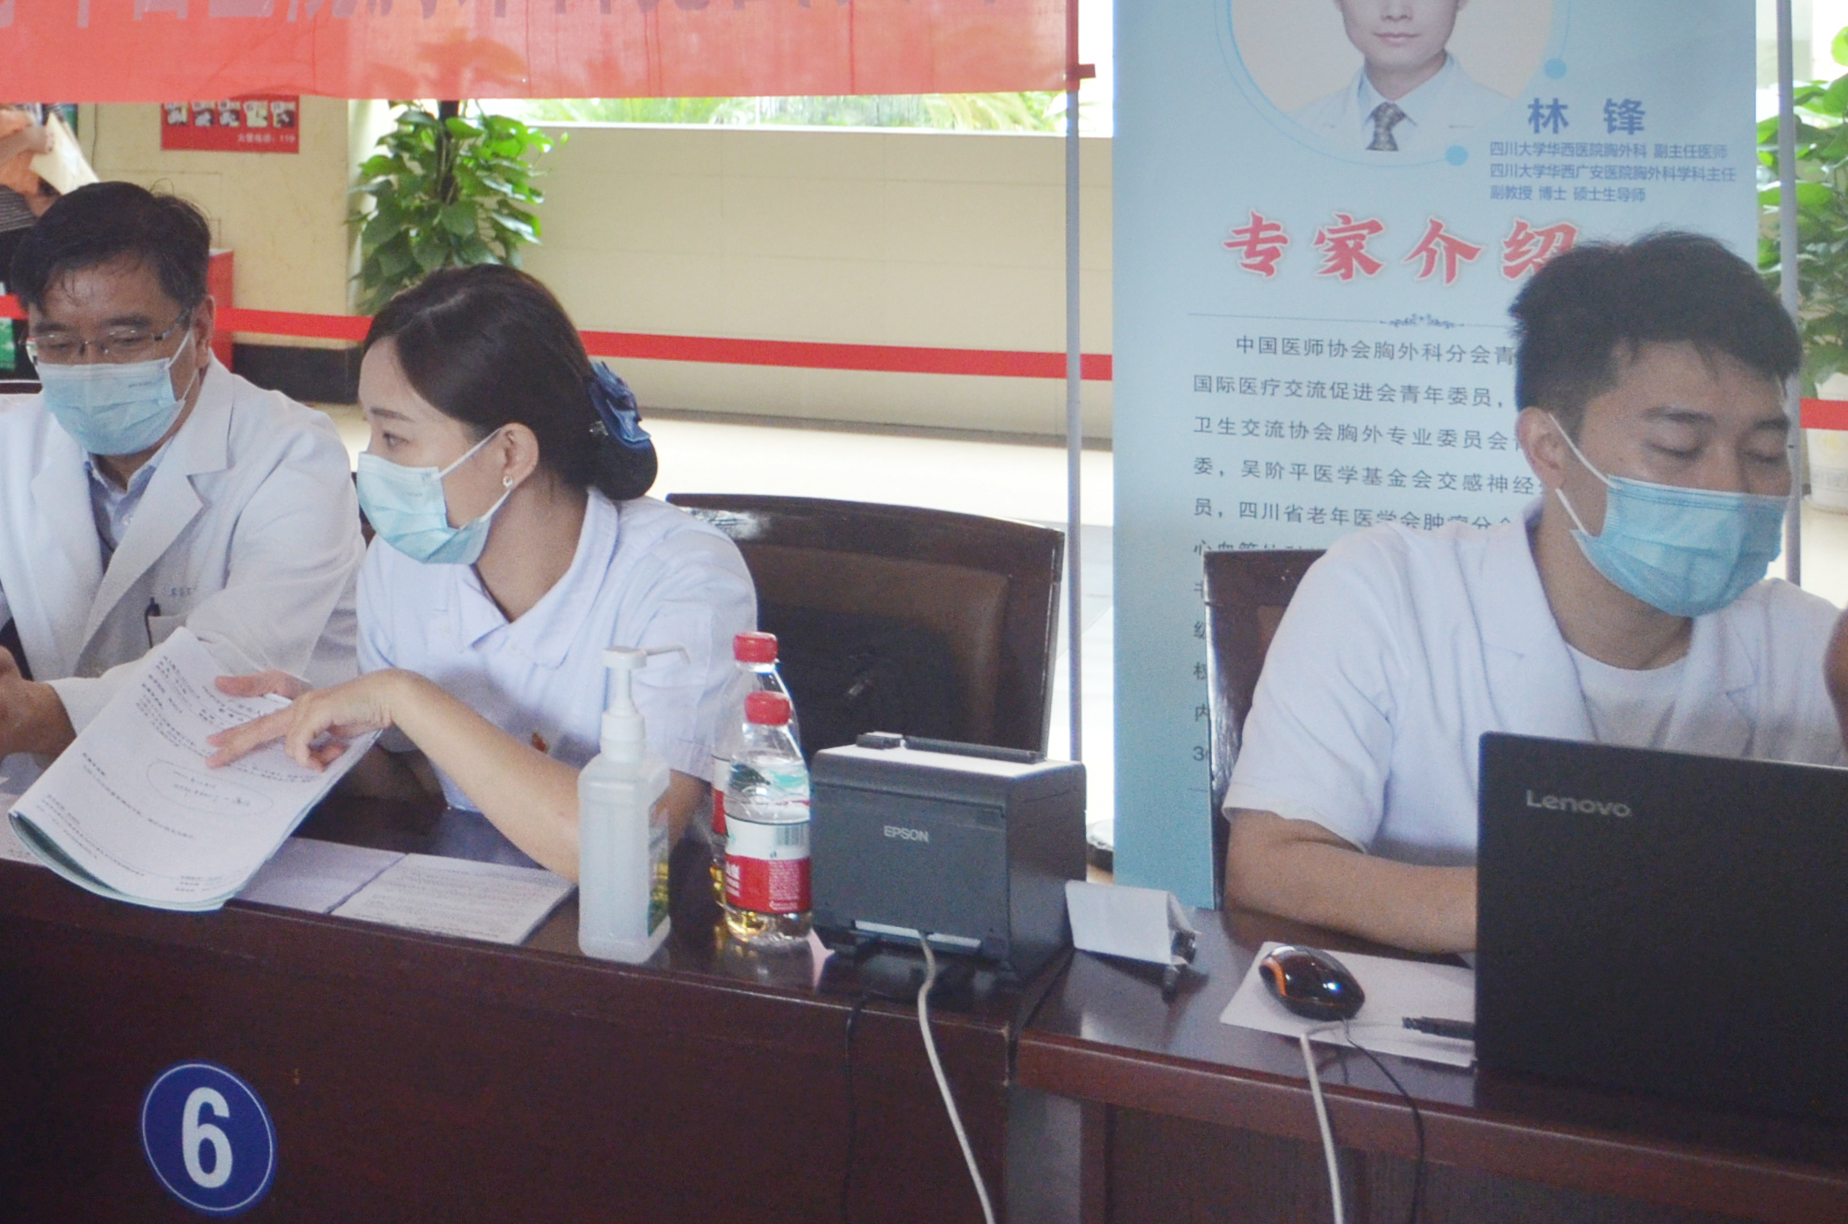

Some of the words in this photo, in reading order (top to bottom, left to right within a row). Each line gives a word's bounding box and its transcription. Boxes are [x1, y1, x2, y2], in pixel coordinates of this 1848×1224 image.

[1489, 141, 1647, 159] 四川大学华西医院胸外科
[1653, 143, 1728, 160] 副主任医师
[1489, 163, 1737, 182] 四川大学华西广安医院胸外科学科主任
[1489, 184, 1533, 201] 副教授
[1538, 185, 1567, 201] 博士
[1573, 186, 1647, 203] 硕士生导师
[1235, 335, 1516, 366] 中国医师协会胸外科分会青
[1193, 374, 1504, 408] 国际医疗交流促进会青年委员，
[1193, 416, 1521, 451] 卫生交流协会胸外专业委员会
[1193, 457, 1542, 495] 委，吴阶平医学基金会交感神经
[1525, 790, 1632, 818] Lenovo
[883, 825, 929, 843] EPSON
[181, 1087, 234, 1189] 6
